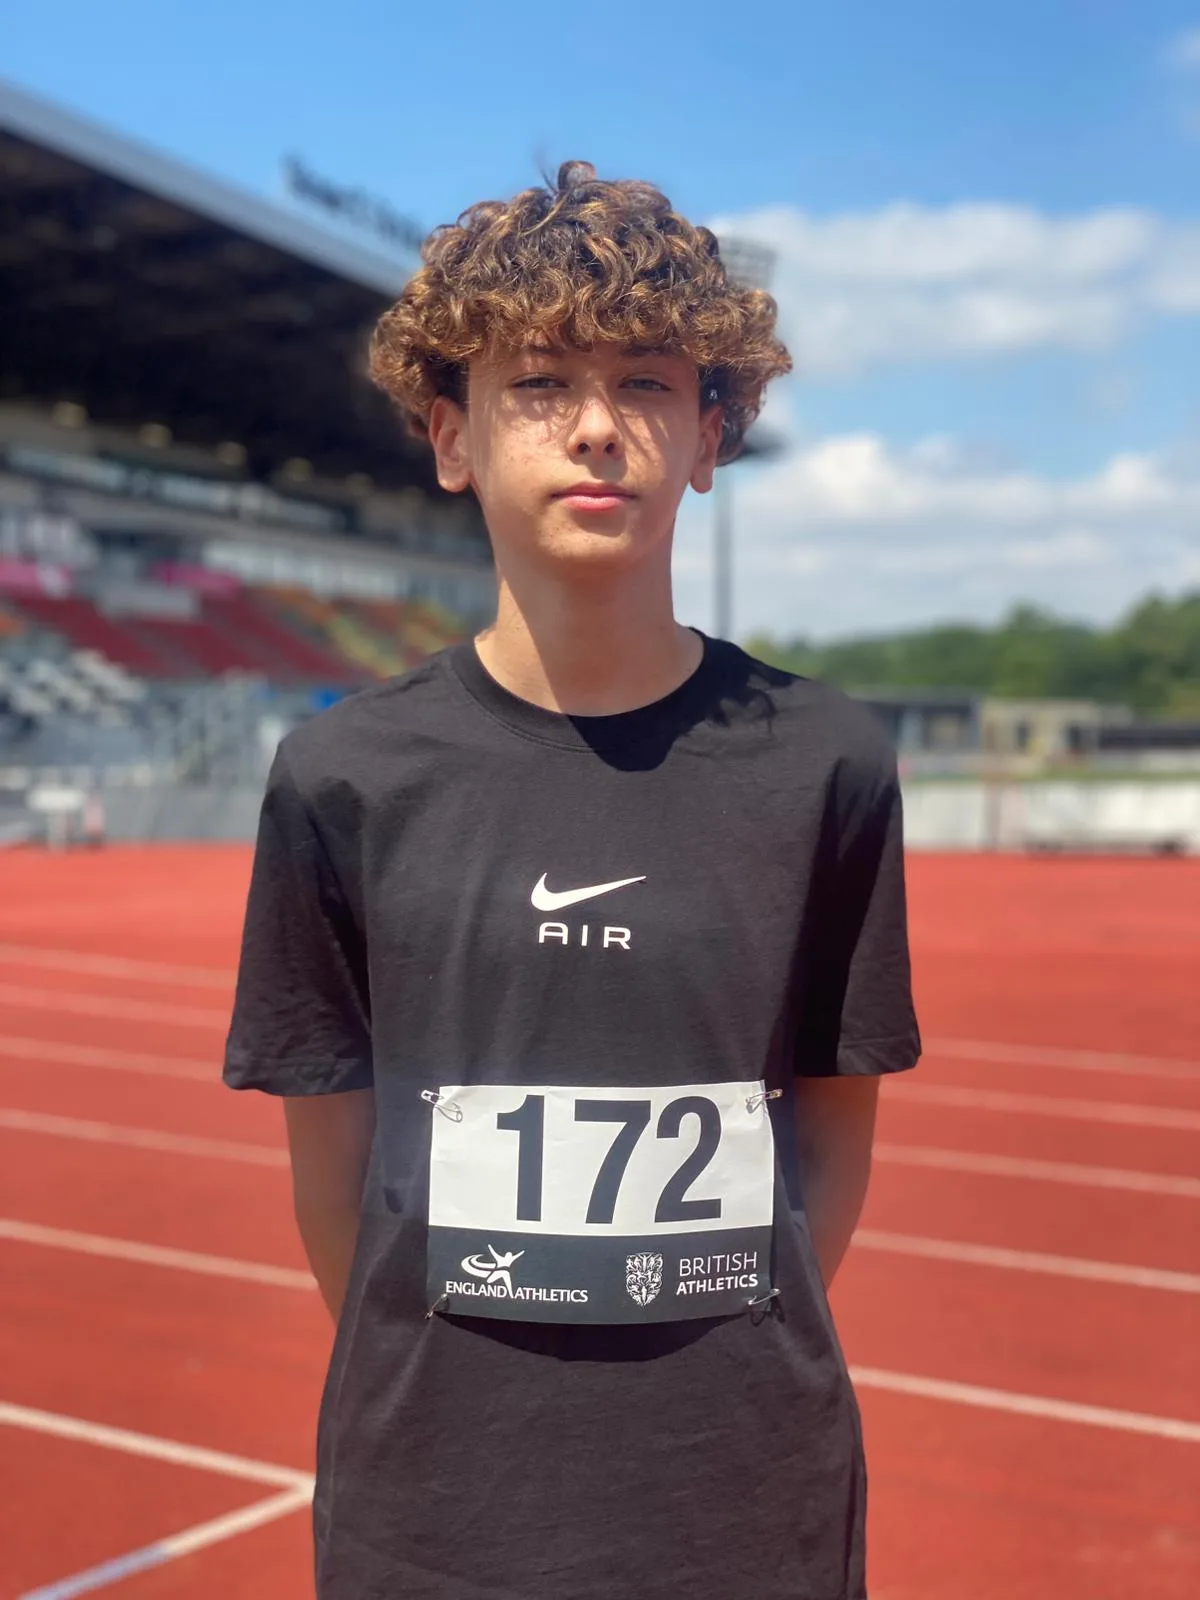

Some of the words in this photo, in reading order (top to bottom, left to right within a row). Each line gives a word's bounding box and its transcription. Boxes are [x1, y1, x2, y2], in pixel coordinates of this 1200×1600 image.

[538, 921, 631, 950] AIR
[496, 1094, 722, 1224] 172
[679, 1251, 757, 1277] BRITISH
[445, 1280, 508, 1298] ENGLAND
[514, 1287, 589, 1304] ATHLETICS
[676, 1273, 759, 1296] ATHLETICS
